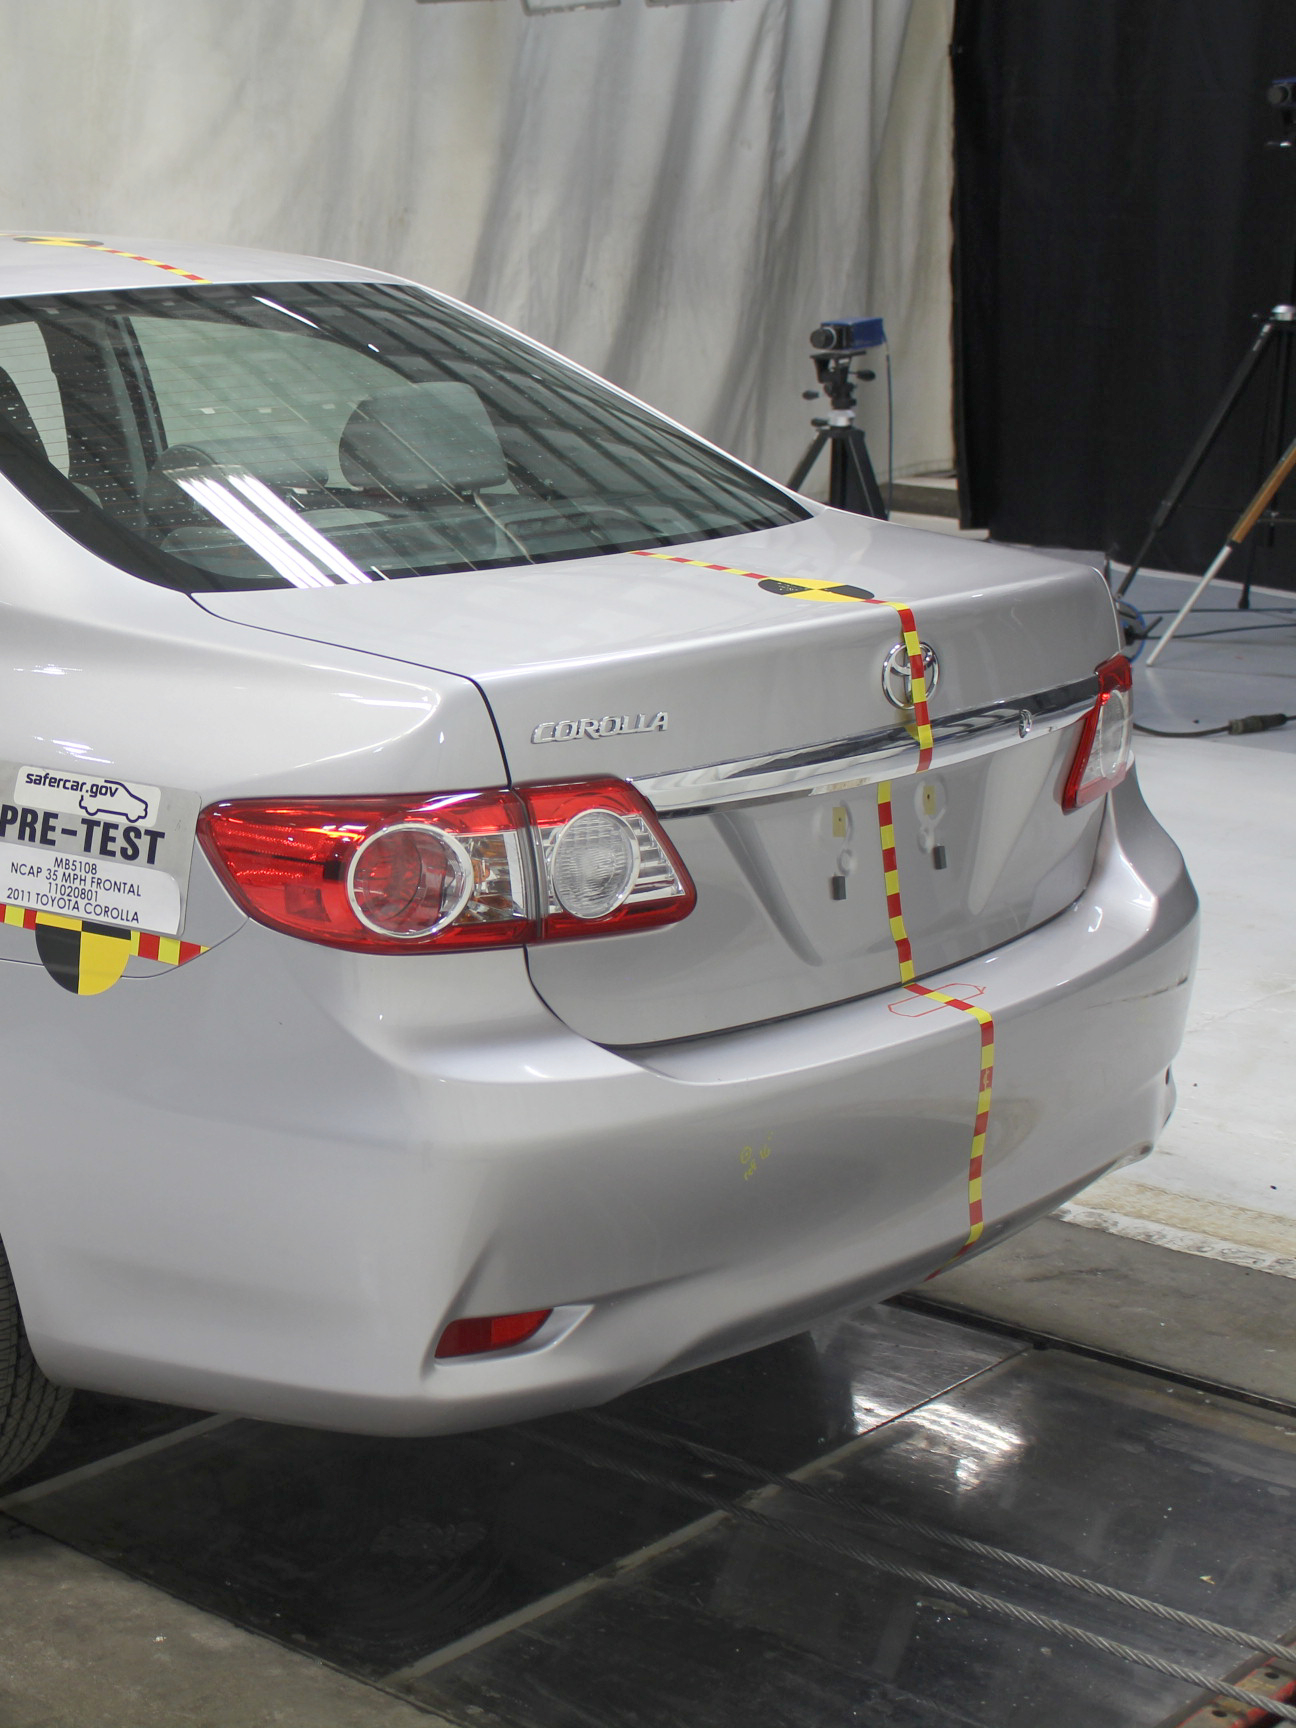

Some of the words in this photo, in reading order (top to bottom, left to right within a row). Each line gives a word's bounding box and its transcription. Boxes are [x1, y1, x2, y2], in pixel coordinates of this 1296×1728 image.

[531, 711, 669, 745] COROLLA
[25, 773, 119, 798] safercar.gov
[10, 862, 43, 878] NCAP
[45, 869, 59, 882] 35
[61, 871, 87, 887] MPH
[90, 876, 142, 898] FRONTAL
[53, 856, 98, 876] MB5108
[6, 887, 32, 903] 2011
[35, 892, 80, 913] TOYOTA
[84, 902, 140, 924] COROLLA
[48, 882, 99, 902] 11020801
